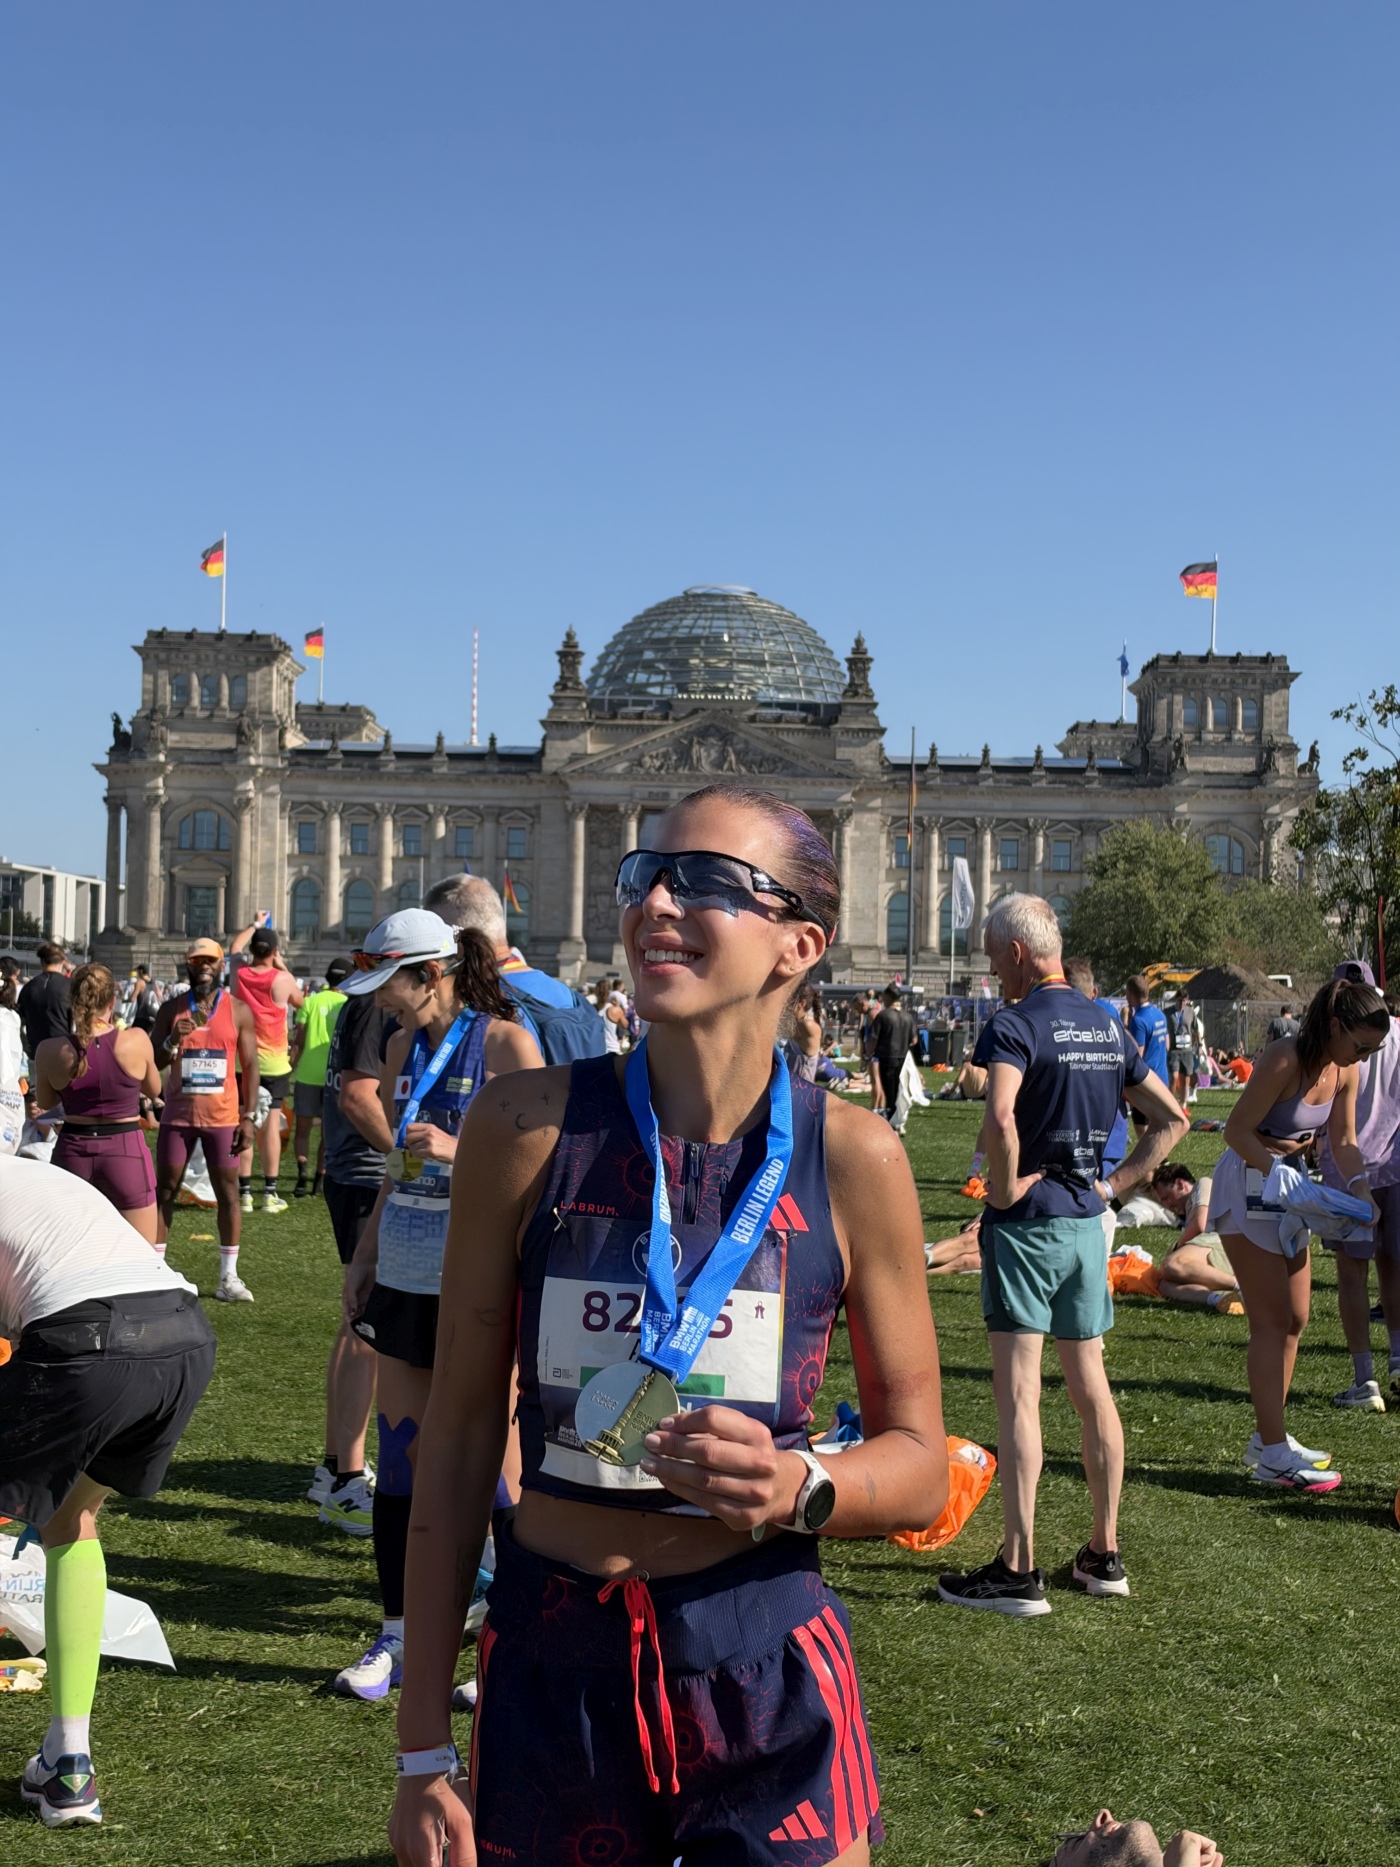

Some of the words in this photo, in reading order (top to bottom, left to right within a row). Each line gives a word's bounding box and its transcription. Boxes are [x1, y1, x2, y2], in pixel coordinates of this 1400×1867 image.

[1058, 1052, 1085, 1063] HAPPY
[1085, 1052, 1124, 1064] BIRTHDAY
[560, 1200, 619, 1217] LABRUM.
[730, 1199, 766, 1245] BERLIN
[751, 1157, 784, 1203] LEGEND
[582, 1290, 733, 1339] 825
[669, 1319, 690, 1350] BMW
[680, 1324, 697, 1352] BERLIN
[688, 1315, 711, 1356] MARATHON
